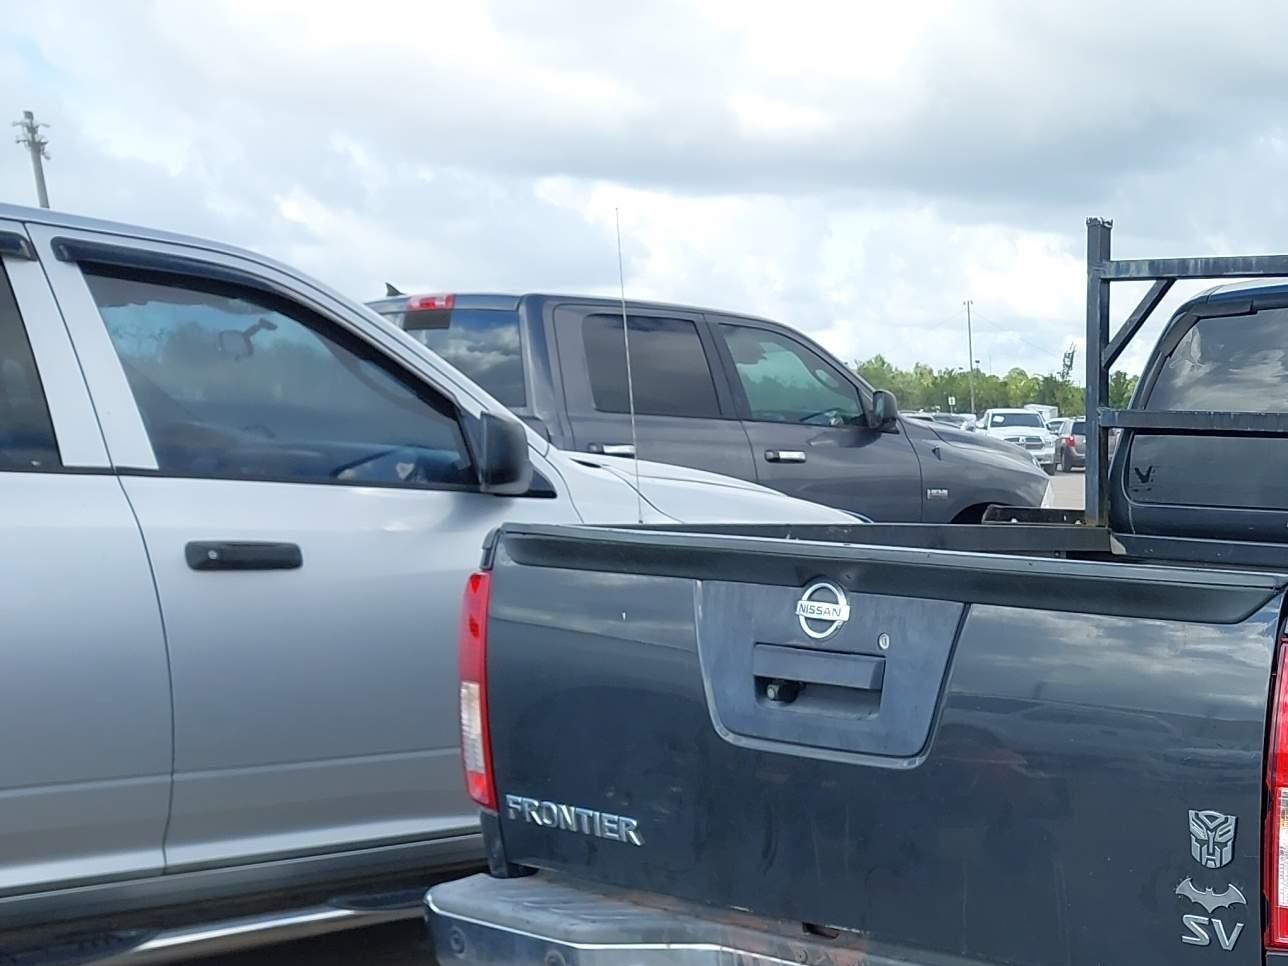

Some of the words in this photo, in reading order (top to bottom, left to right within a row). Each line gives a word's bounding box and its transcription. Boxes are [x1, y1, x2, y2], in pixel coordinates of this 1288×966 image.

[799, 603, 842, 618] NISSAN
[505, 794, 645, 847] FRONTIER
[1181, 914, 1245, 952] SV
